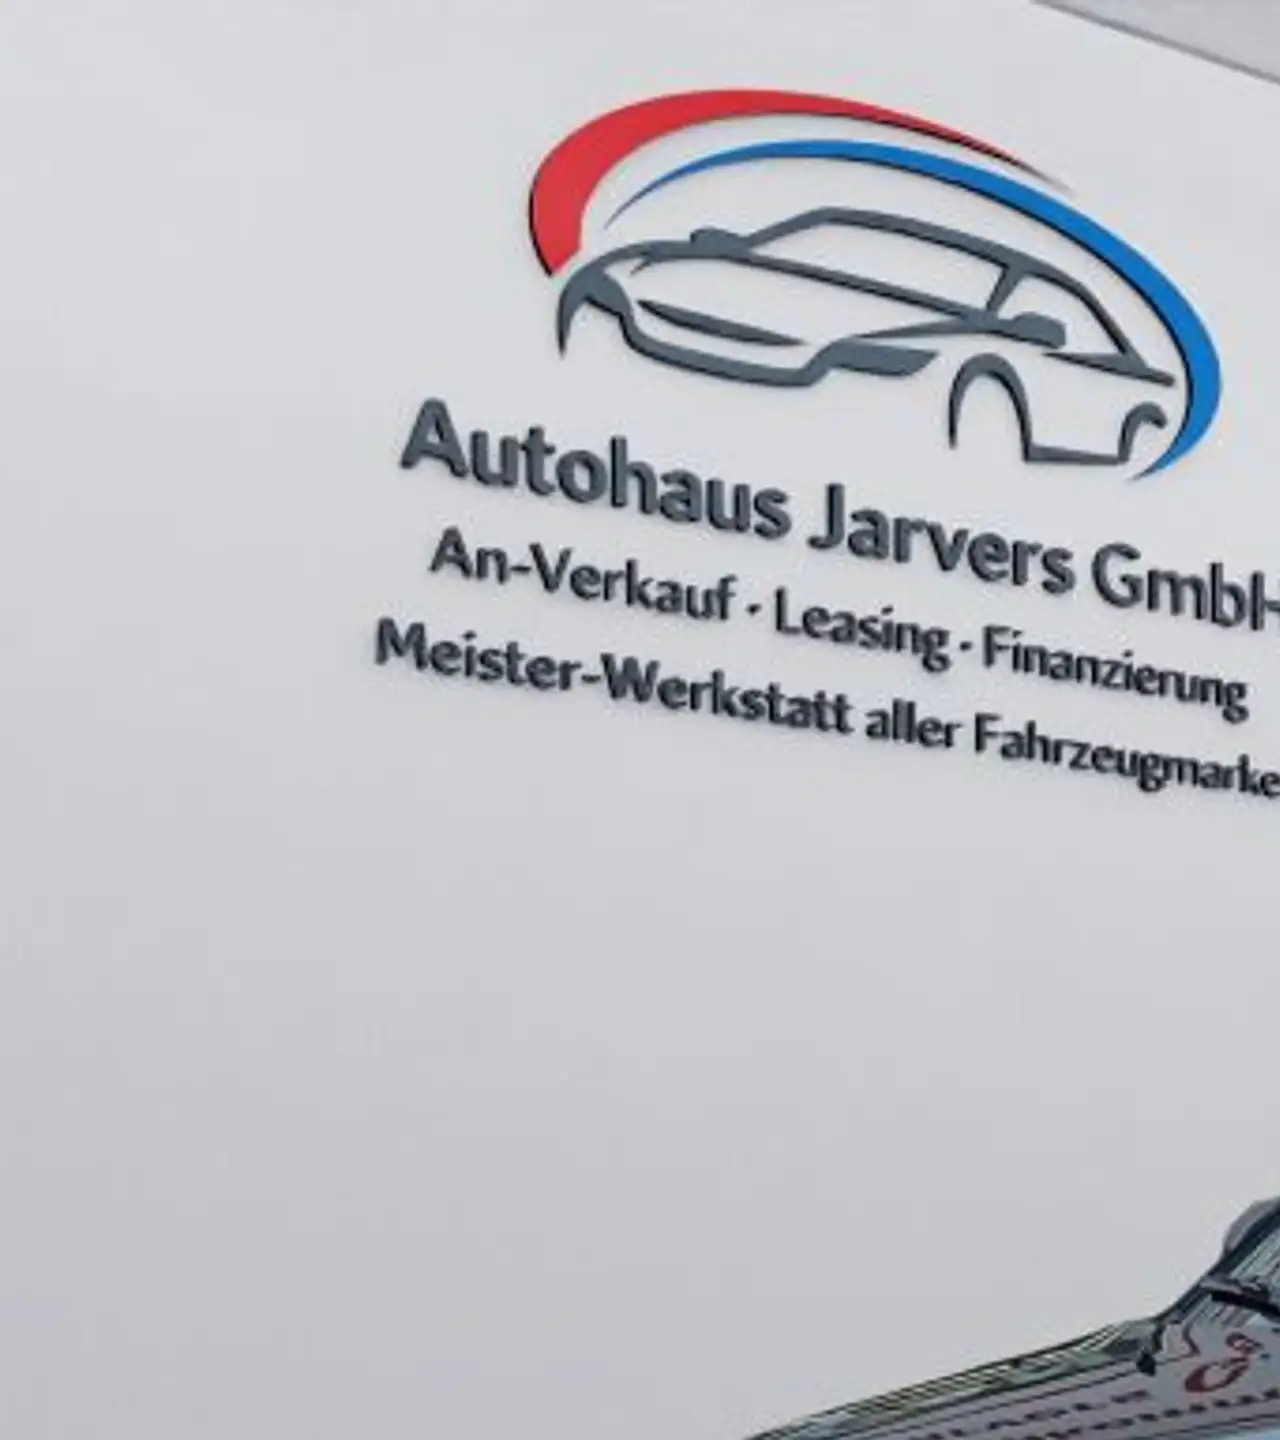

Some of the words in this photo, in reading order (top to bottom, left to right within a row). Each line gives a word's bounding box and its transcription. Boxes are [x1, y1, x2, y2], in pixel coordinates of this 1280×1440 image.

[399, 398, 793, 542] Autohaus
[806, 483, 1077, 596] Jarvers
[375, 616, 855, 737] Meister-Werkstatt
[864, 698, 963, 750] aller
[429, 526, 738, 623] An-Verkauf
[775, 587, 952, 674] Leasing
[982, 625, 1250, 726] Finanzierung
